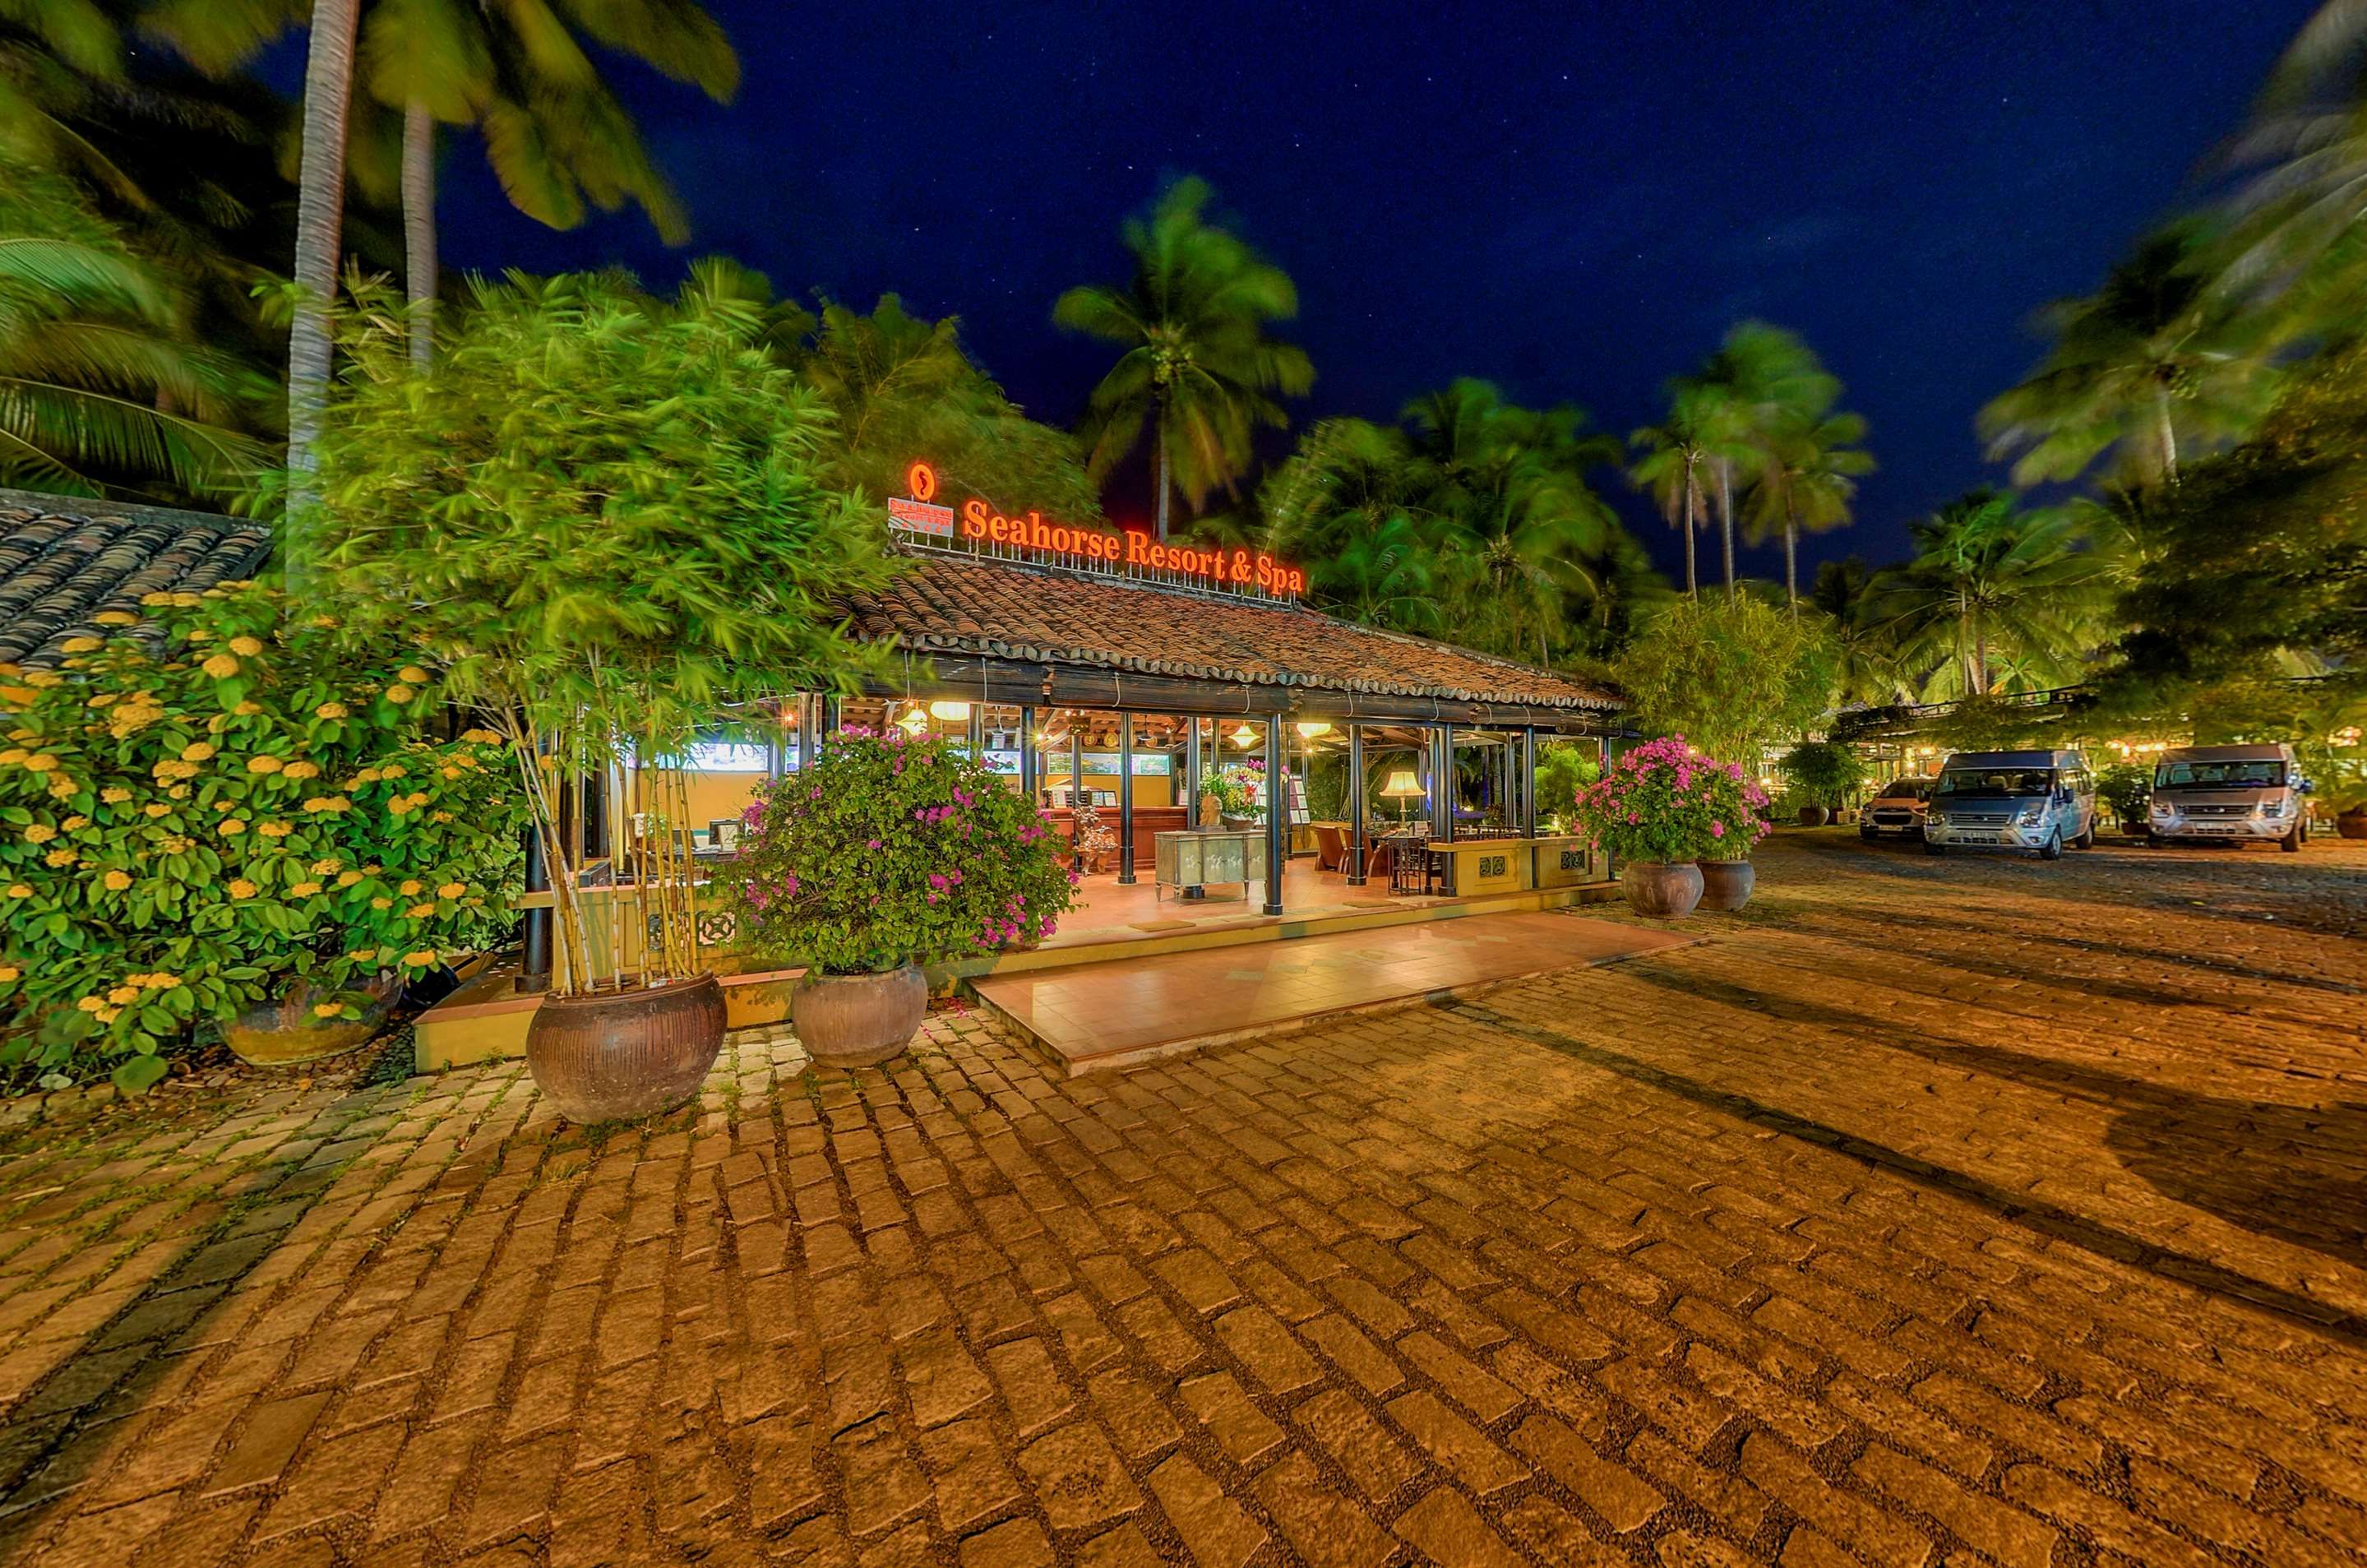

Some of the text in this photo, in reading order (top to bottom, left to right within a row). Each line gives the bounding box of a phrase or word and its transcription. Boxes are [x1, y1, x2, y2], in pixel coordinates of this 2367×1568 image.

[964, 500, 1120, 560] Seahorse
[1126, 530, 1225, 580] Resort
[1231, 550, 1251, 582] &
[1257, 555, 1302, 595] Spa
